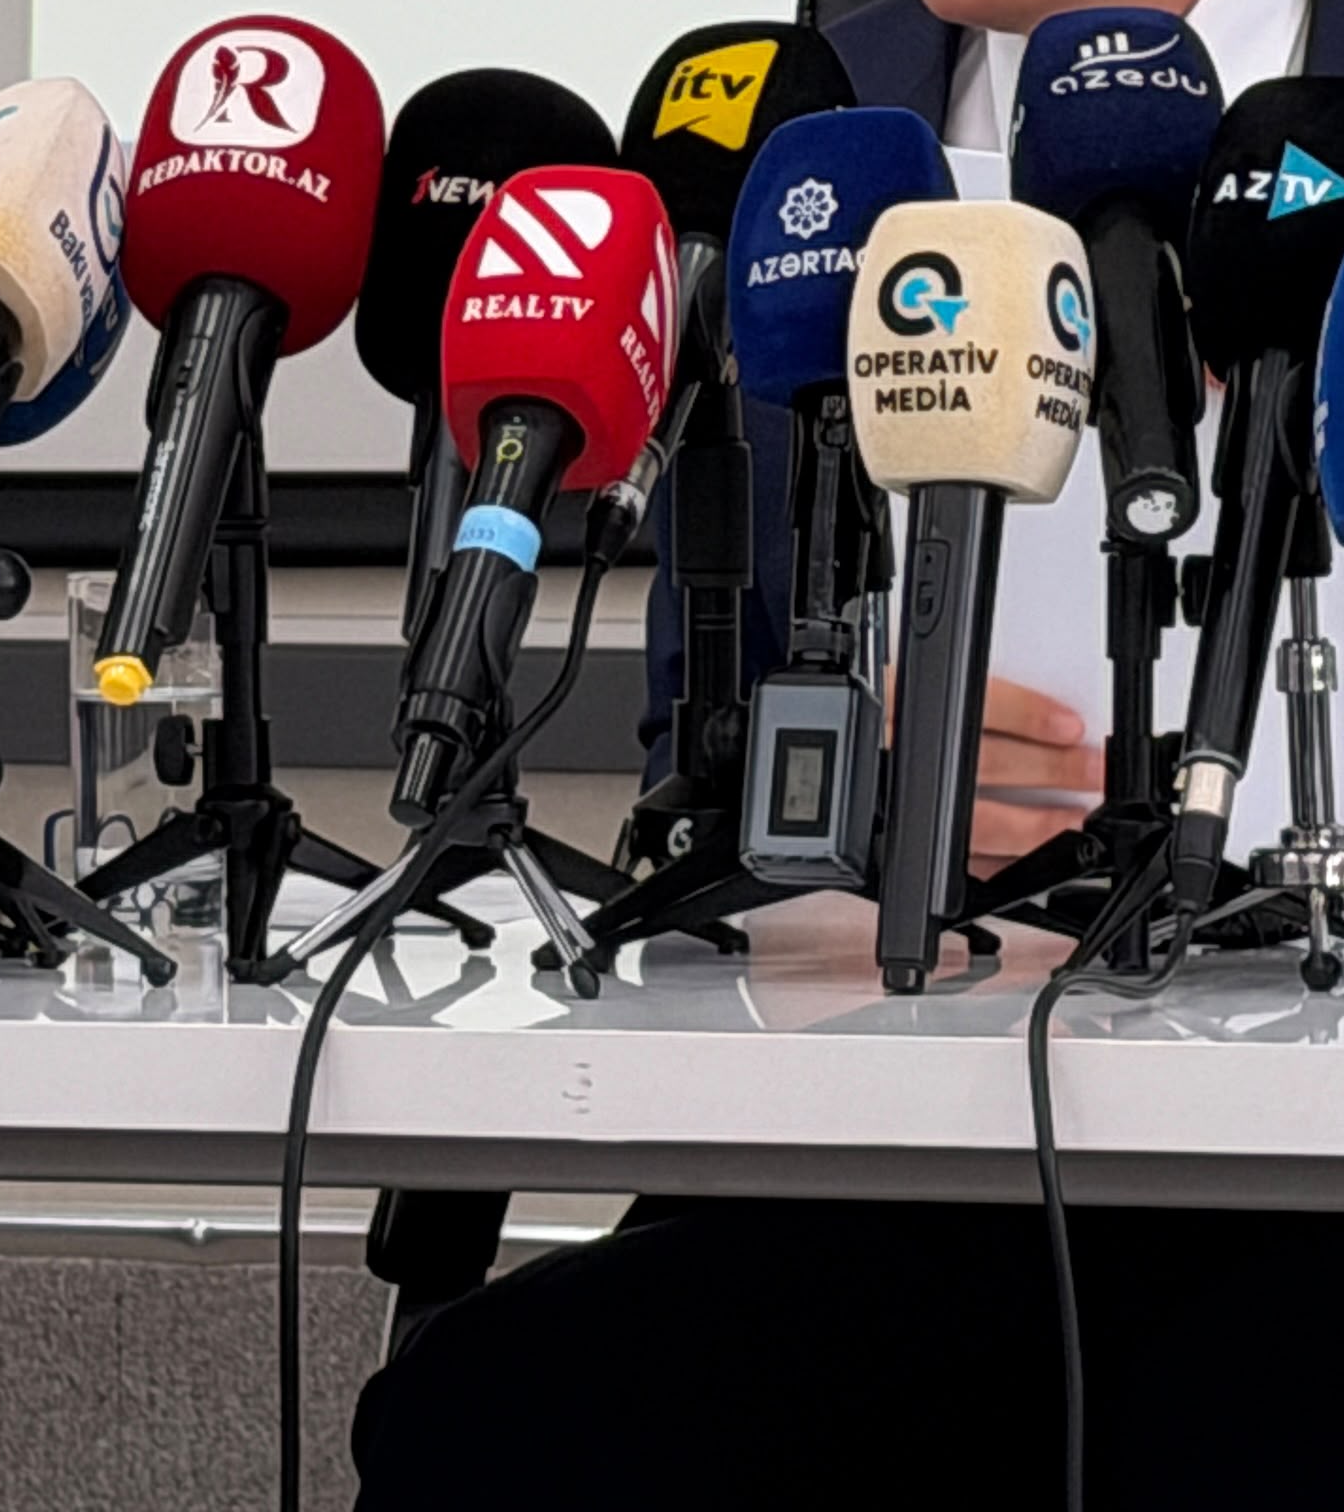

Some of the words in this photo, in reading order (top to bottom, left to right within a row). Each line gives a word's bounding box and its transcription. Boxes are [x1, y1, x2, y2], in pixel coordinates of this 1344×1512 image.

[671, 66, 754, 103] itv
[1050, 67, 1209, 97] azedu
[137, 148, 331, 203] REDAKTOR.AZ
[462, 294, 545, 323] REAL
[550, 295, 595, 321] TV
